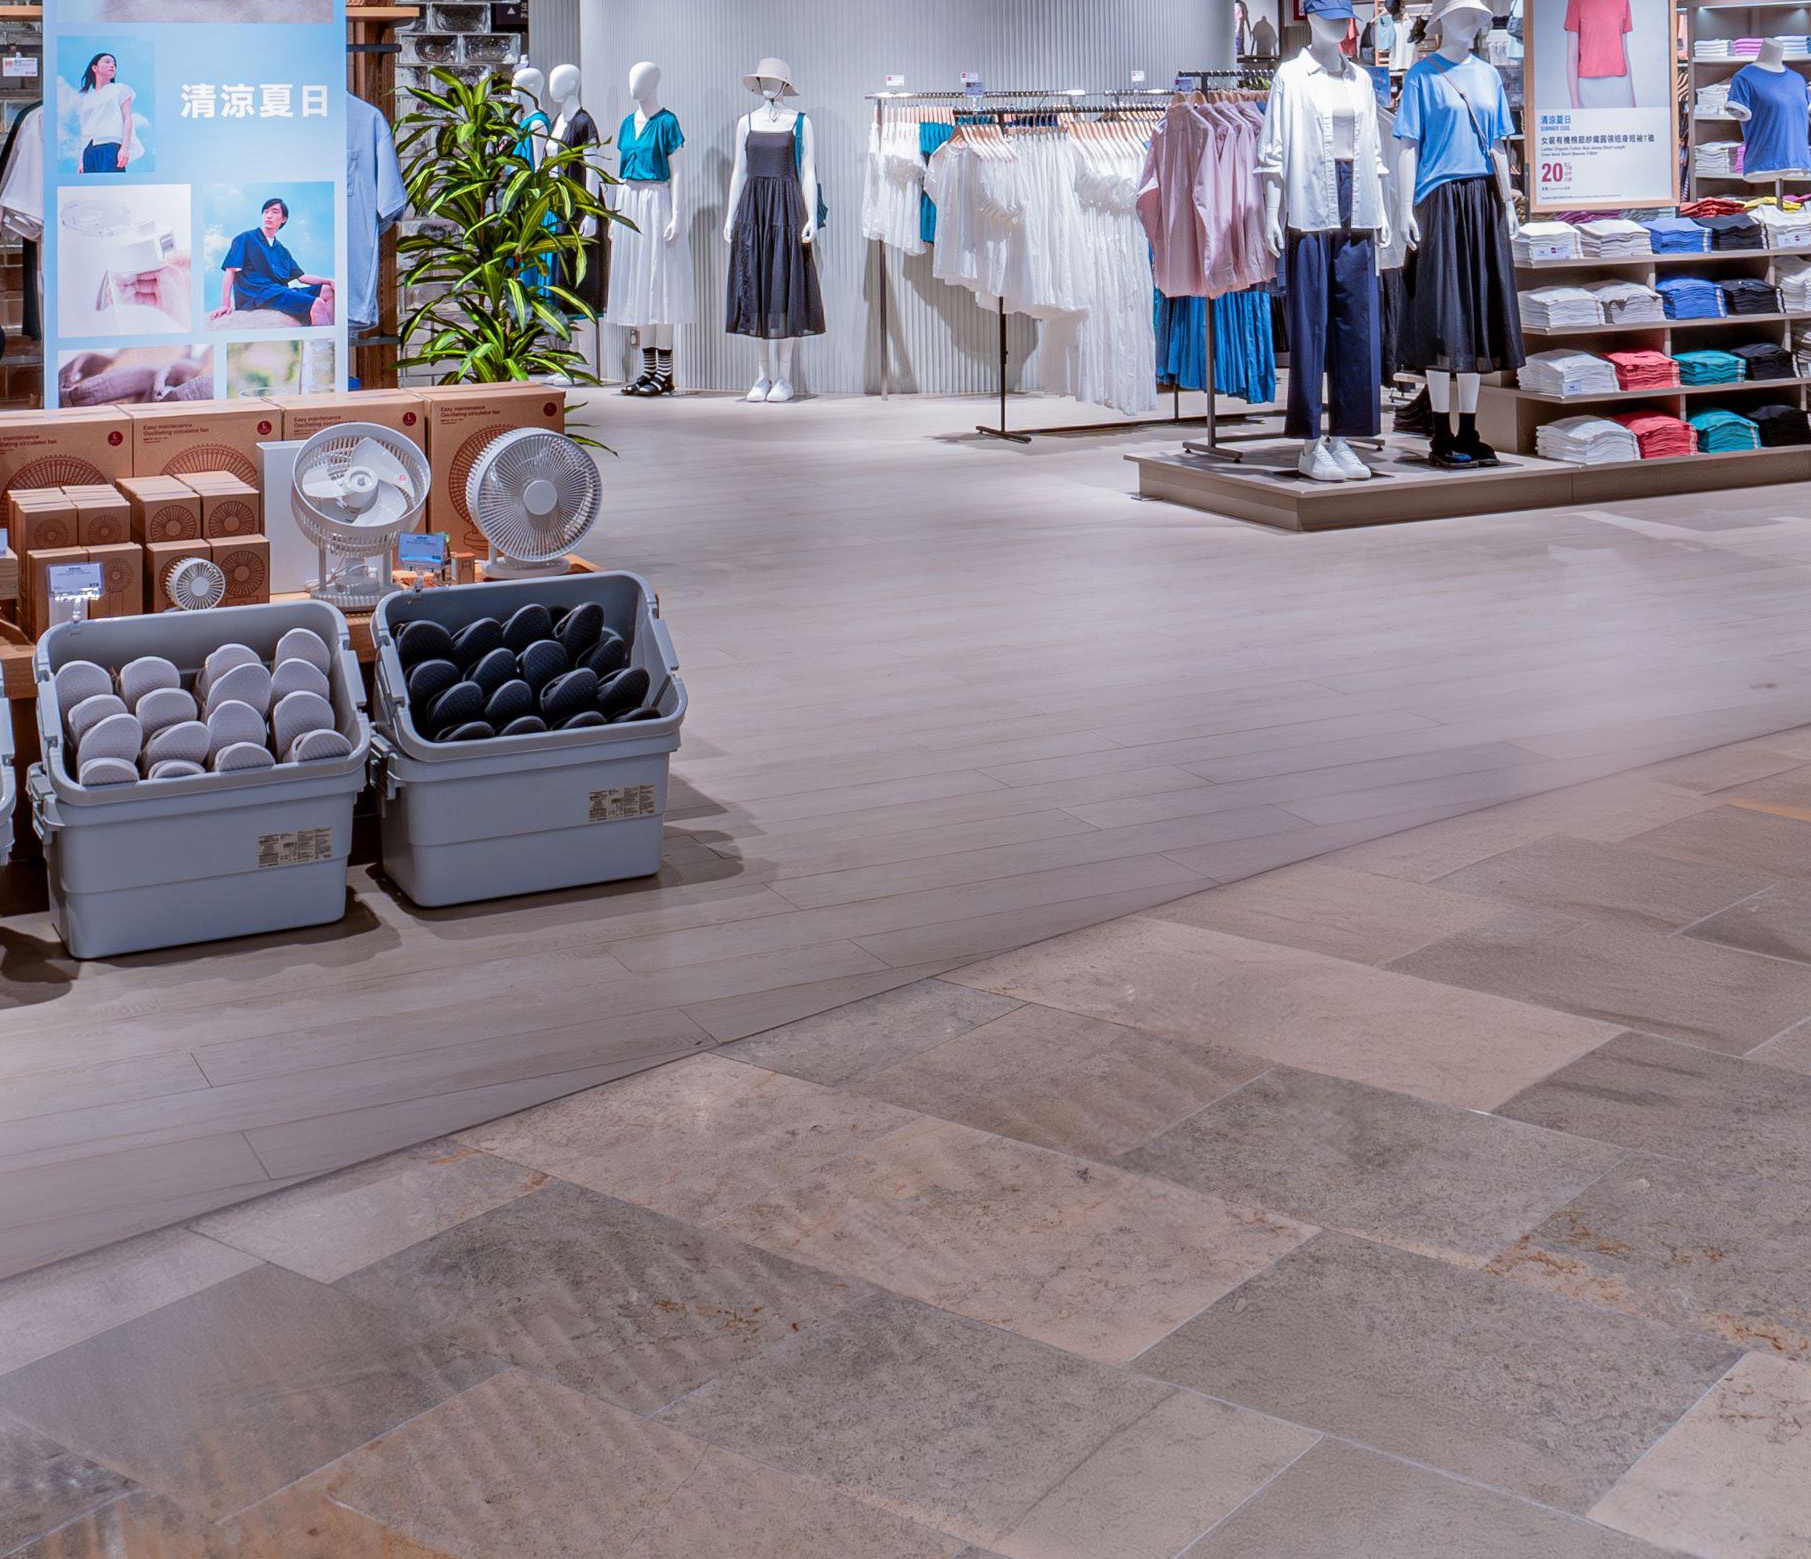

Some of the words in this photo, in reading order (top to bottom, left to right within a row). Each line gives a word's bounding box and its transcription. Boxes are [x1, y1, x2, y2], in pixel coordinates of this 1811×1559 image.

[180, 83, 329, 119] 清涼夏日
[1541, 162, 1563, 183] 20
